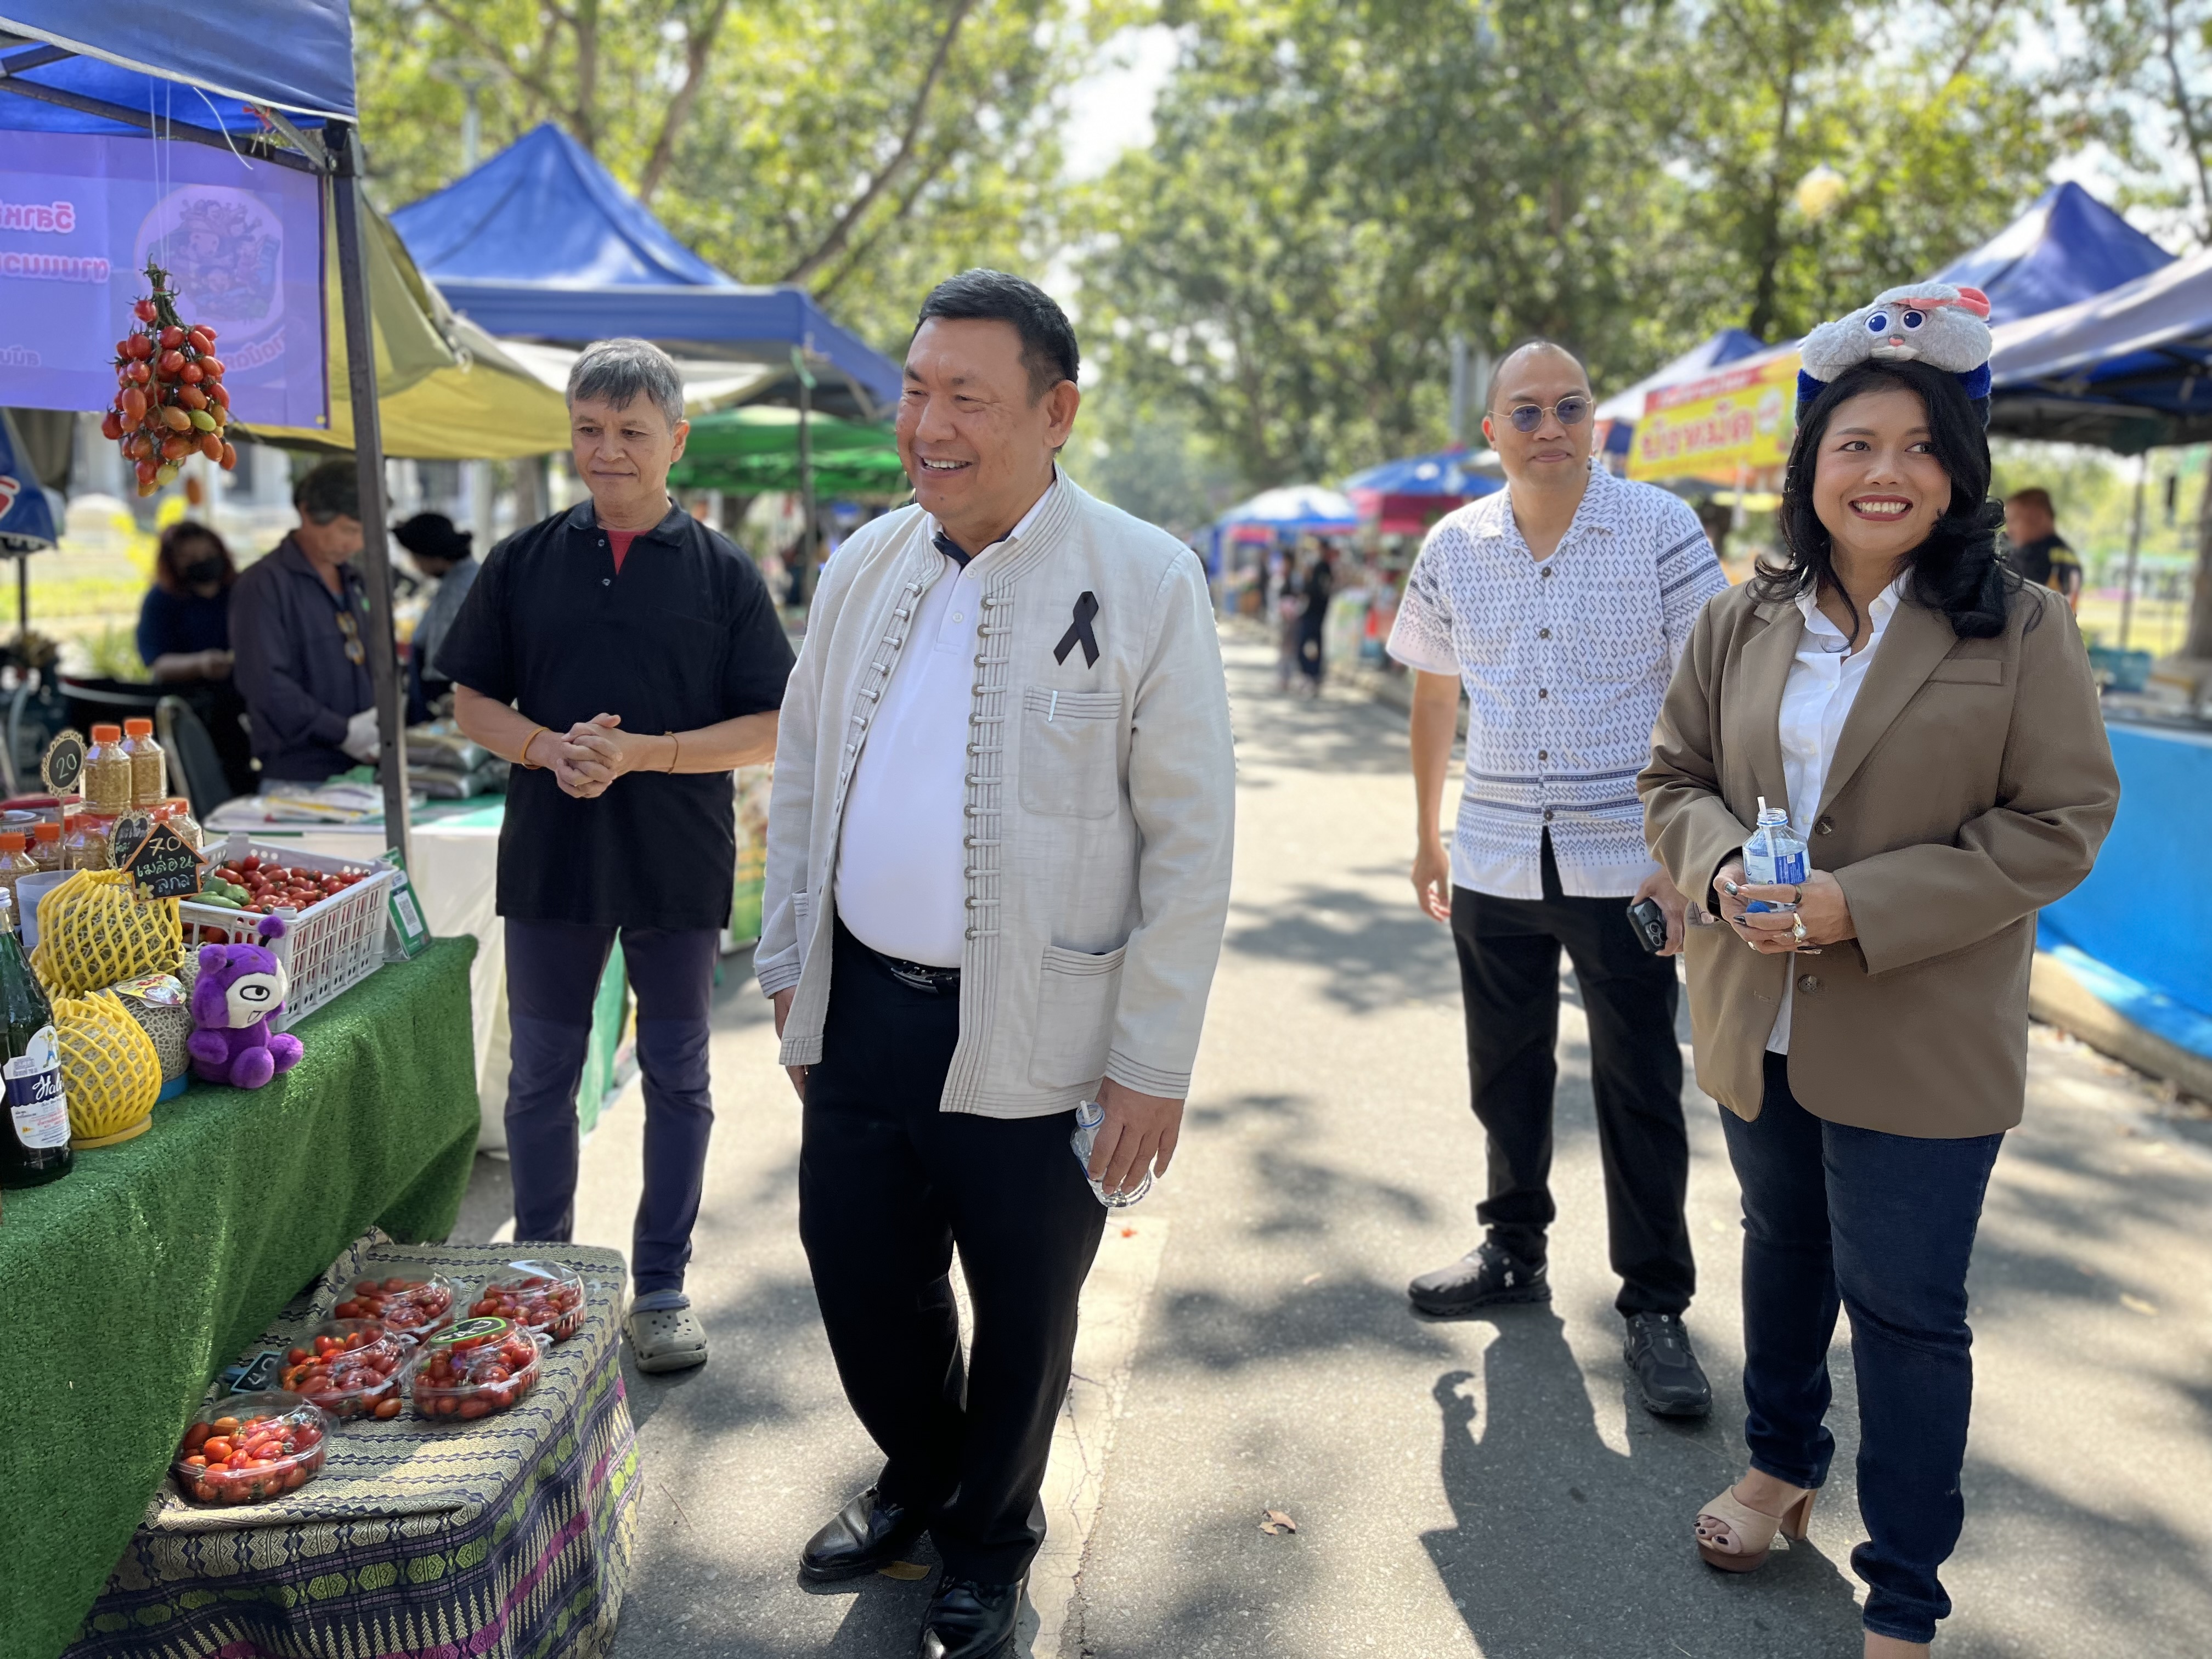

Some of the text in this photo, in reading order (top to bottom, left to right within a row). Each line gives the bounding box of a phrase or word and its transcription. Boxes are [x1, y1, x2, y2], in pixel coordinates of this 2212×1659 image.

[56, 754, 77, 779] 20
[149, 836, 182, 856] 70
[137, 854, 195, 877] เมล่อน
